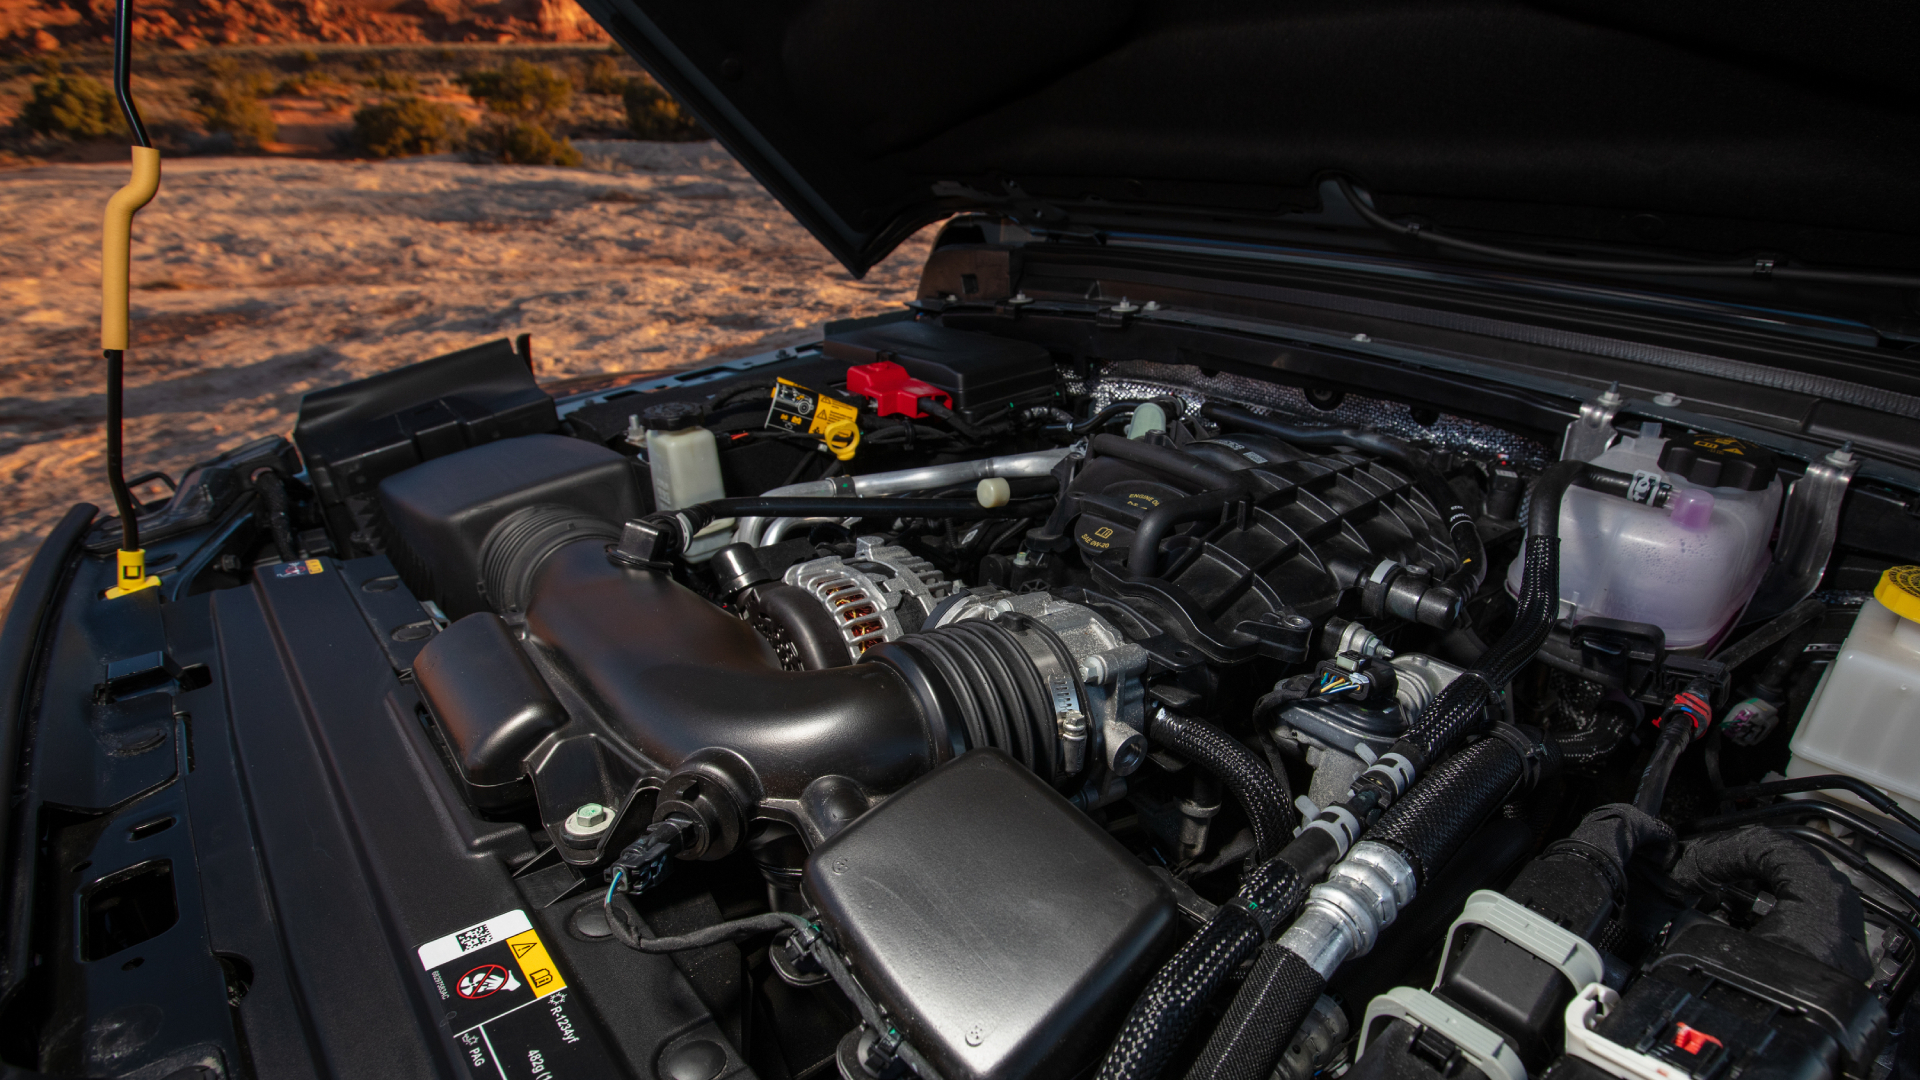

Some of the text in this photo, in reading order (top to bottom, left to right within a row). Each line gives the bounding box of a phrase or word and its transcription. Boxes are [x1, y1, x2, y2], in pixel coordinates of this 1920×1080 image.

[1128, 493, 1154, 502] ENGINE
[1081, 533, 1110, 549] SAE 0W-20
[550, 1006, 580, 1045] R-1234yf
[468, 1047, 486, 1068] PAG
[527, 1049, 545, 1074] 482g
